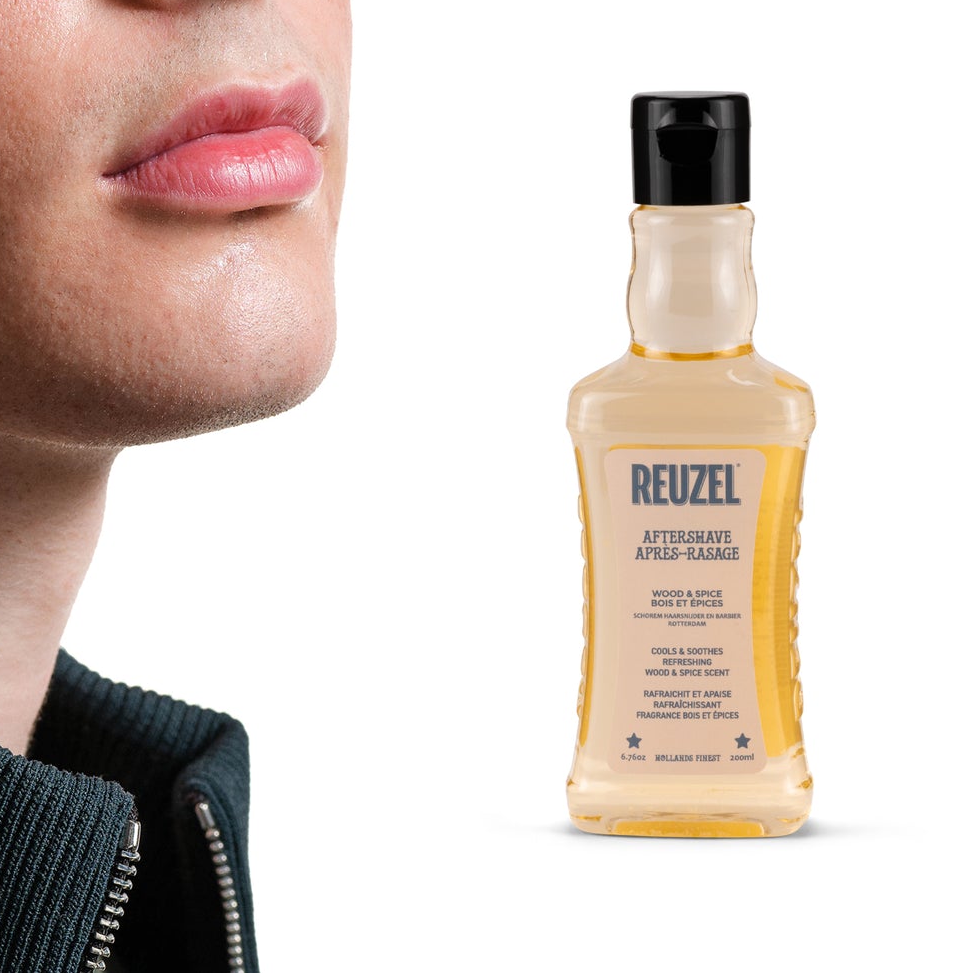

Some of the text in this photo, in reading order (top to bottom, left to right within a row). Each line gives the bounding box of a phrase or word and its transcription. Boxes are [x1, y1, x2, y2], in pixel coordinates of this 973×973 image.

[631, 463, 741, 505] REUZEL
[643, 530, 731, 544] AFTERSHAVE
[635, 544, 739, 560] APRÈS-RASAGE
[691, 598, 723, 607] ÉPICES
[654, 700, 721, 708] RAFRAÎCHISSANT
[713, 711, 739, 719] ÉPICES
[621, 754, 646, 762] 6.76oz
[731, 753, 754, 761] 200ml
